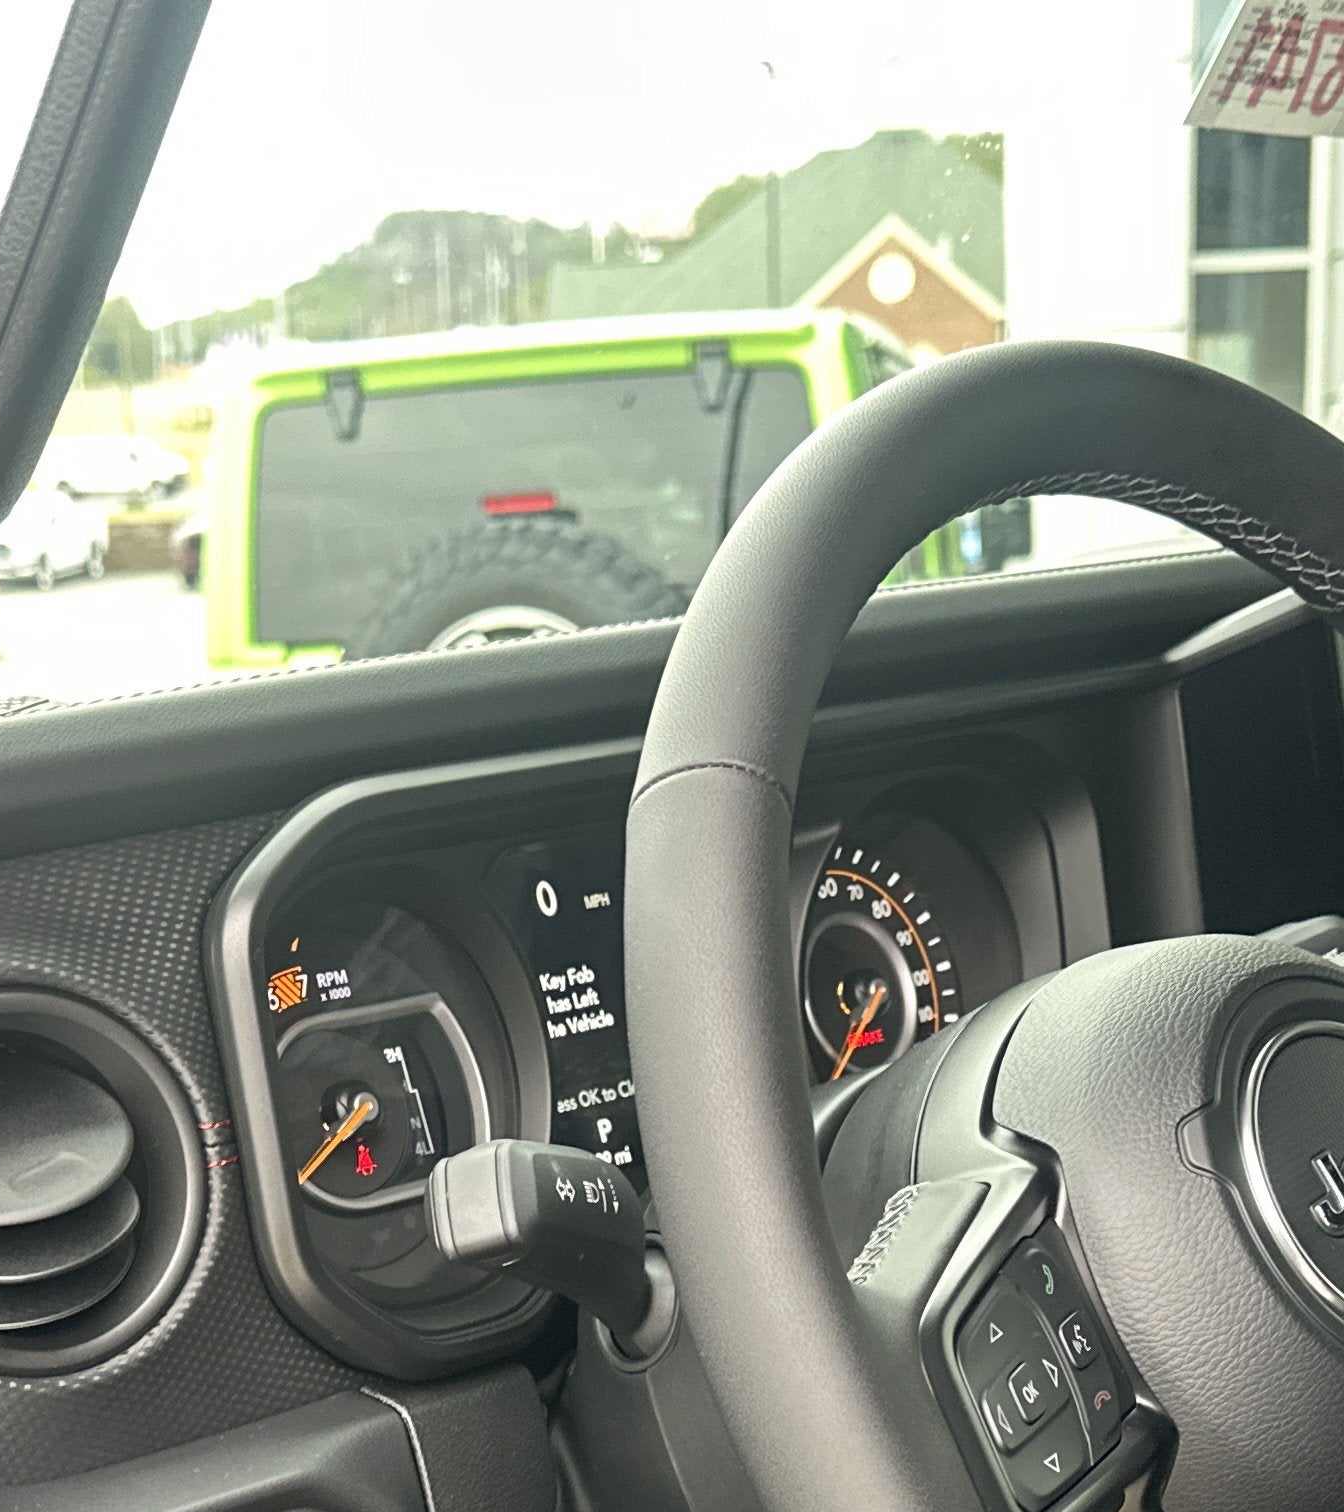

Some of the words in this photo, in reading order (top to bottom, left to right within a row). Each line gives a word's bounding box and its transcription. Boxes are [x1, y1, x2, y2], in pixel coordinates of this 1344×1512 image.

[536, 880, 558, 917] 0
[583, 892, 611, 909] MPH
[846, 884, 864, 901] 70
[871, 899, 892, 919] 80
[896, 930, 913, 947] 90
[296, 974, 308, 998] 7
[315, 969, 349, 988] RPM
[539, 973, 566, 992] Key
[566, 964, 595, 986] Fob
[912, 969, 930, 986] 00
[329, 986, 352, 1000] 1000
[546, 996, 572, 1015] has
[571, 987, 600, 1009] Left
[547, 1020, 567, 1039] he
[565, 1009, 615, 1034] Vehicle
[557, 1097, 578, 1114] ess
[577, 1088, 602, 1107] OK
[601, 1088, 617, 1102] to
[596, 1118, 613, 1143] P
[614, 1145, 633, 1166] mi
[1022, 1380, 1040, 1404] OK
